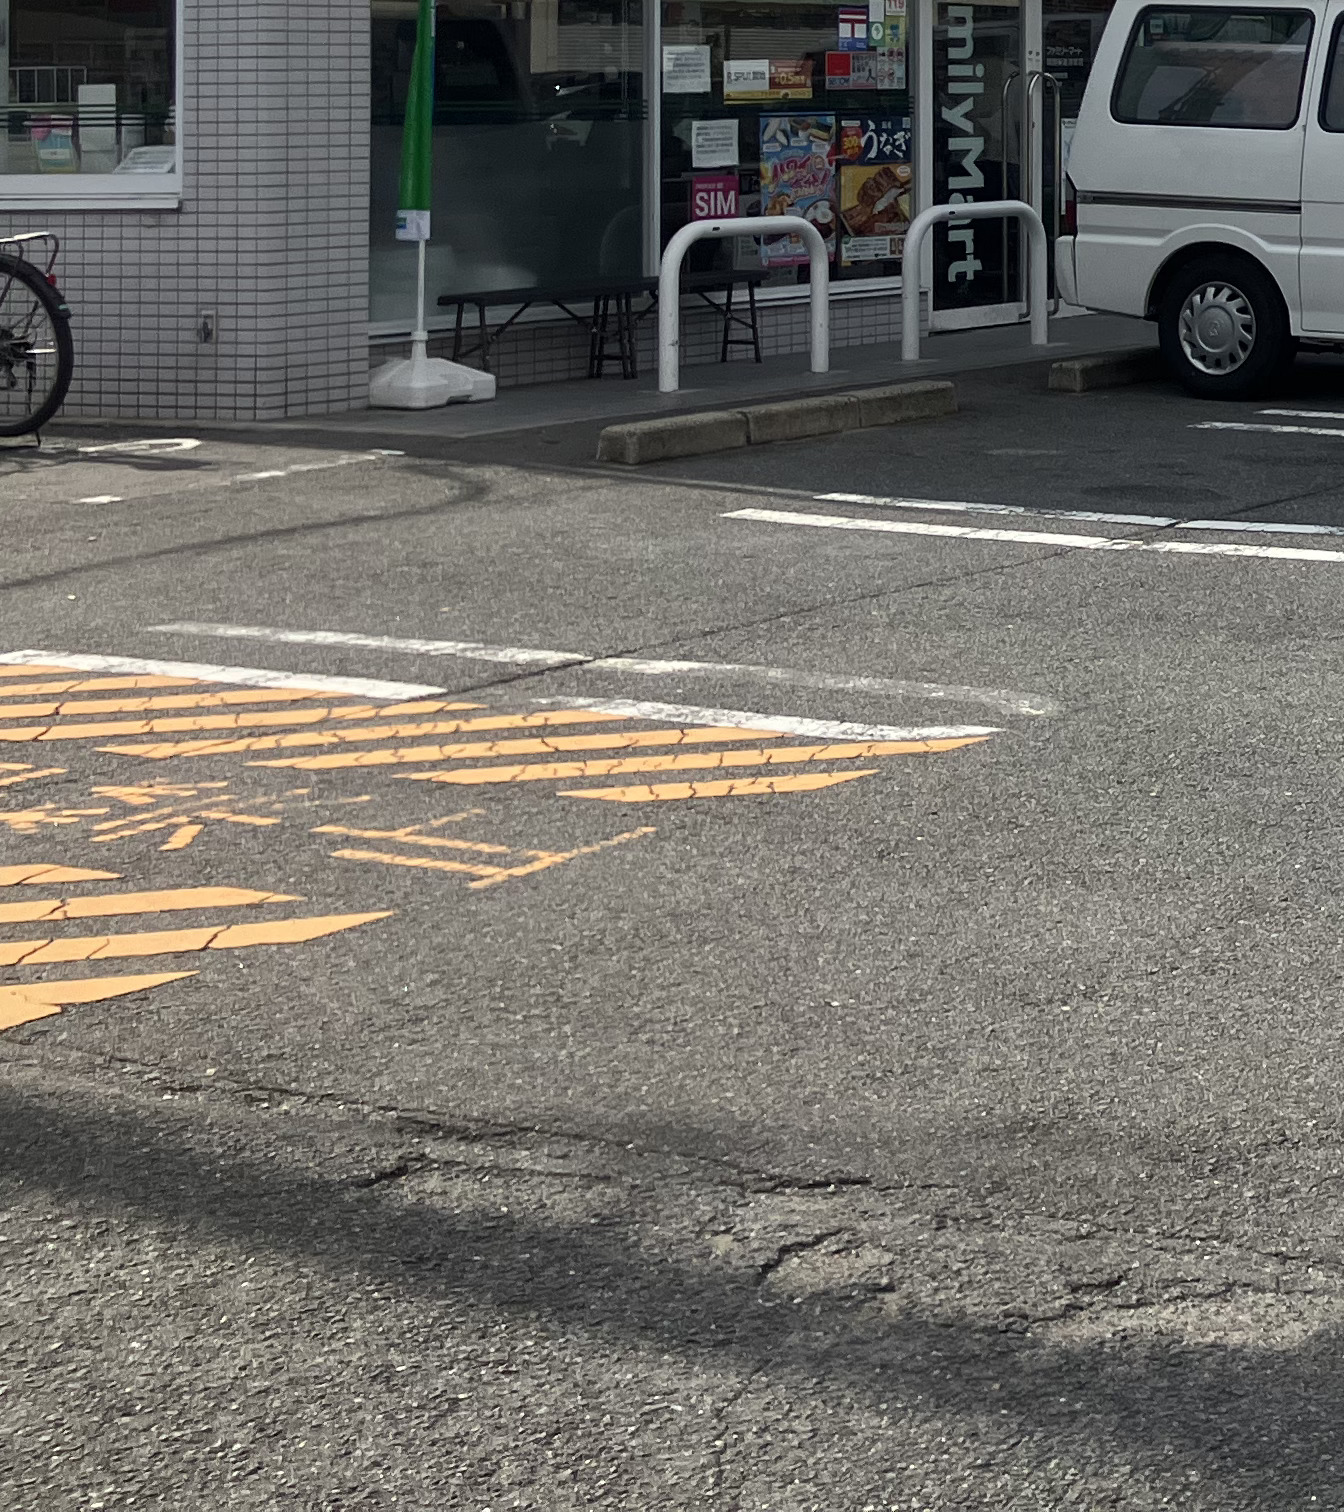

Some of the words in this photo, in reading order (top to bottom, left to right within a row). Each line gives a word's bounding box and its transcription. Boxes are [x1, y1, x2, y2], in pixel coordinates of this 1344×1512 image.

[861, 120, 911, 162] うなぎ
[695, 190, 736, 217] SIM
